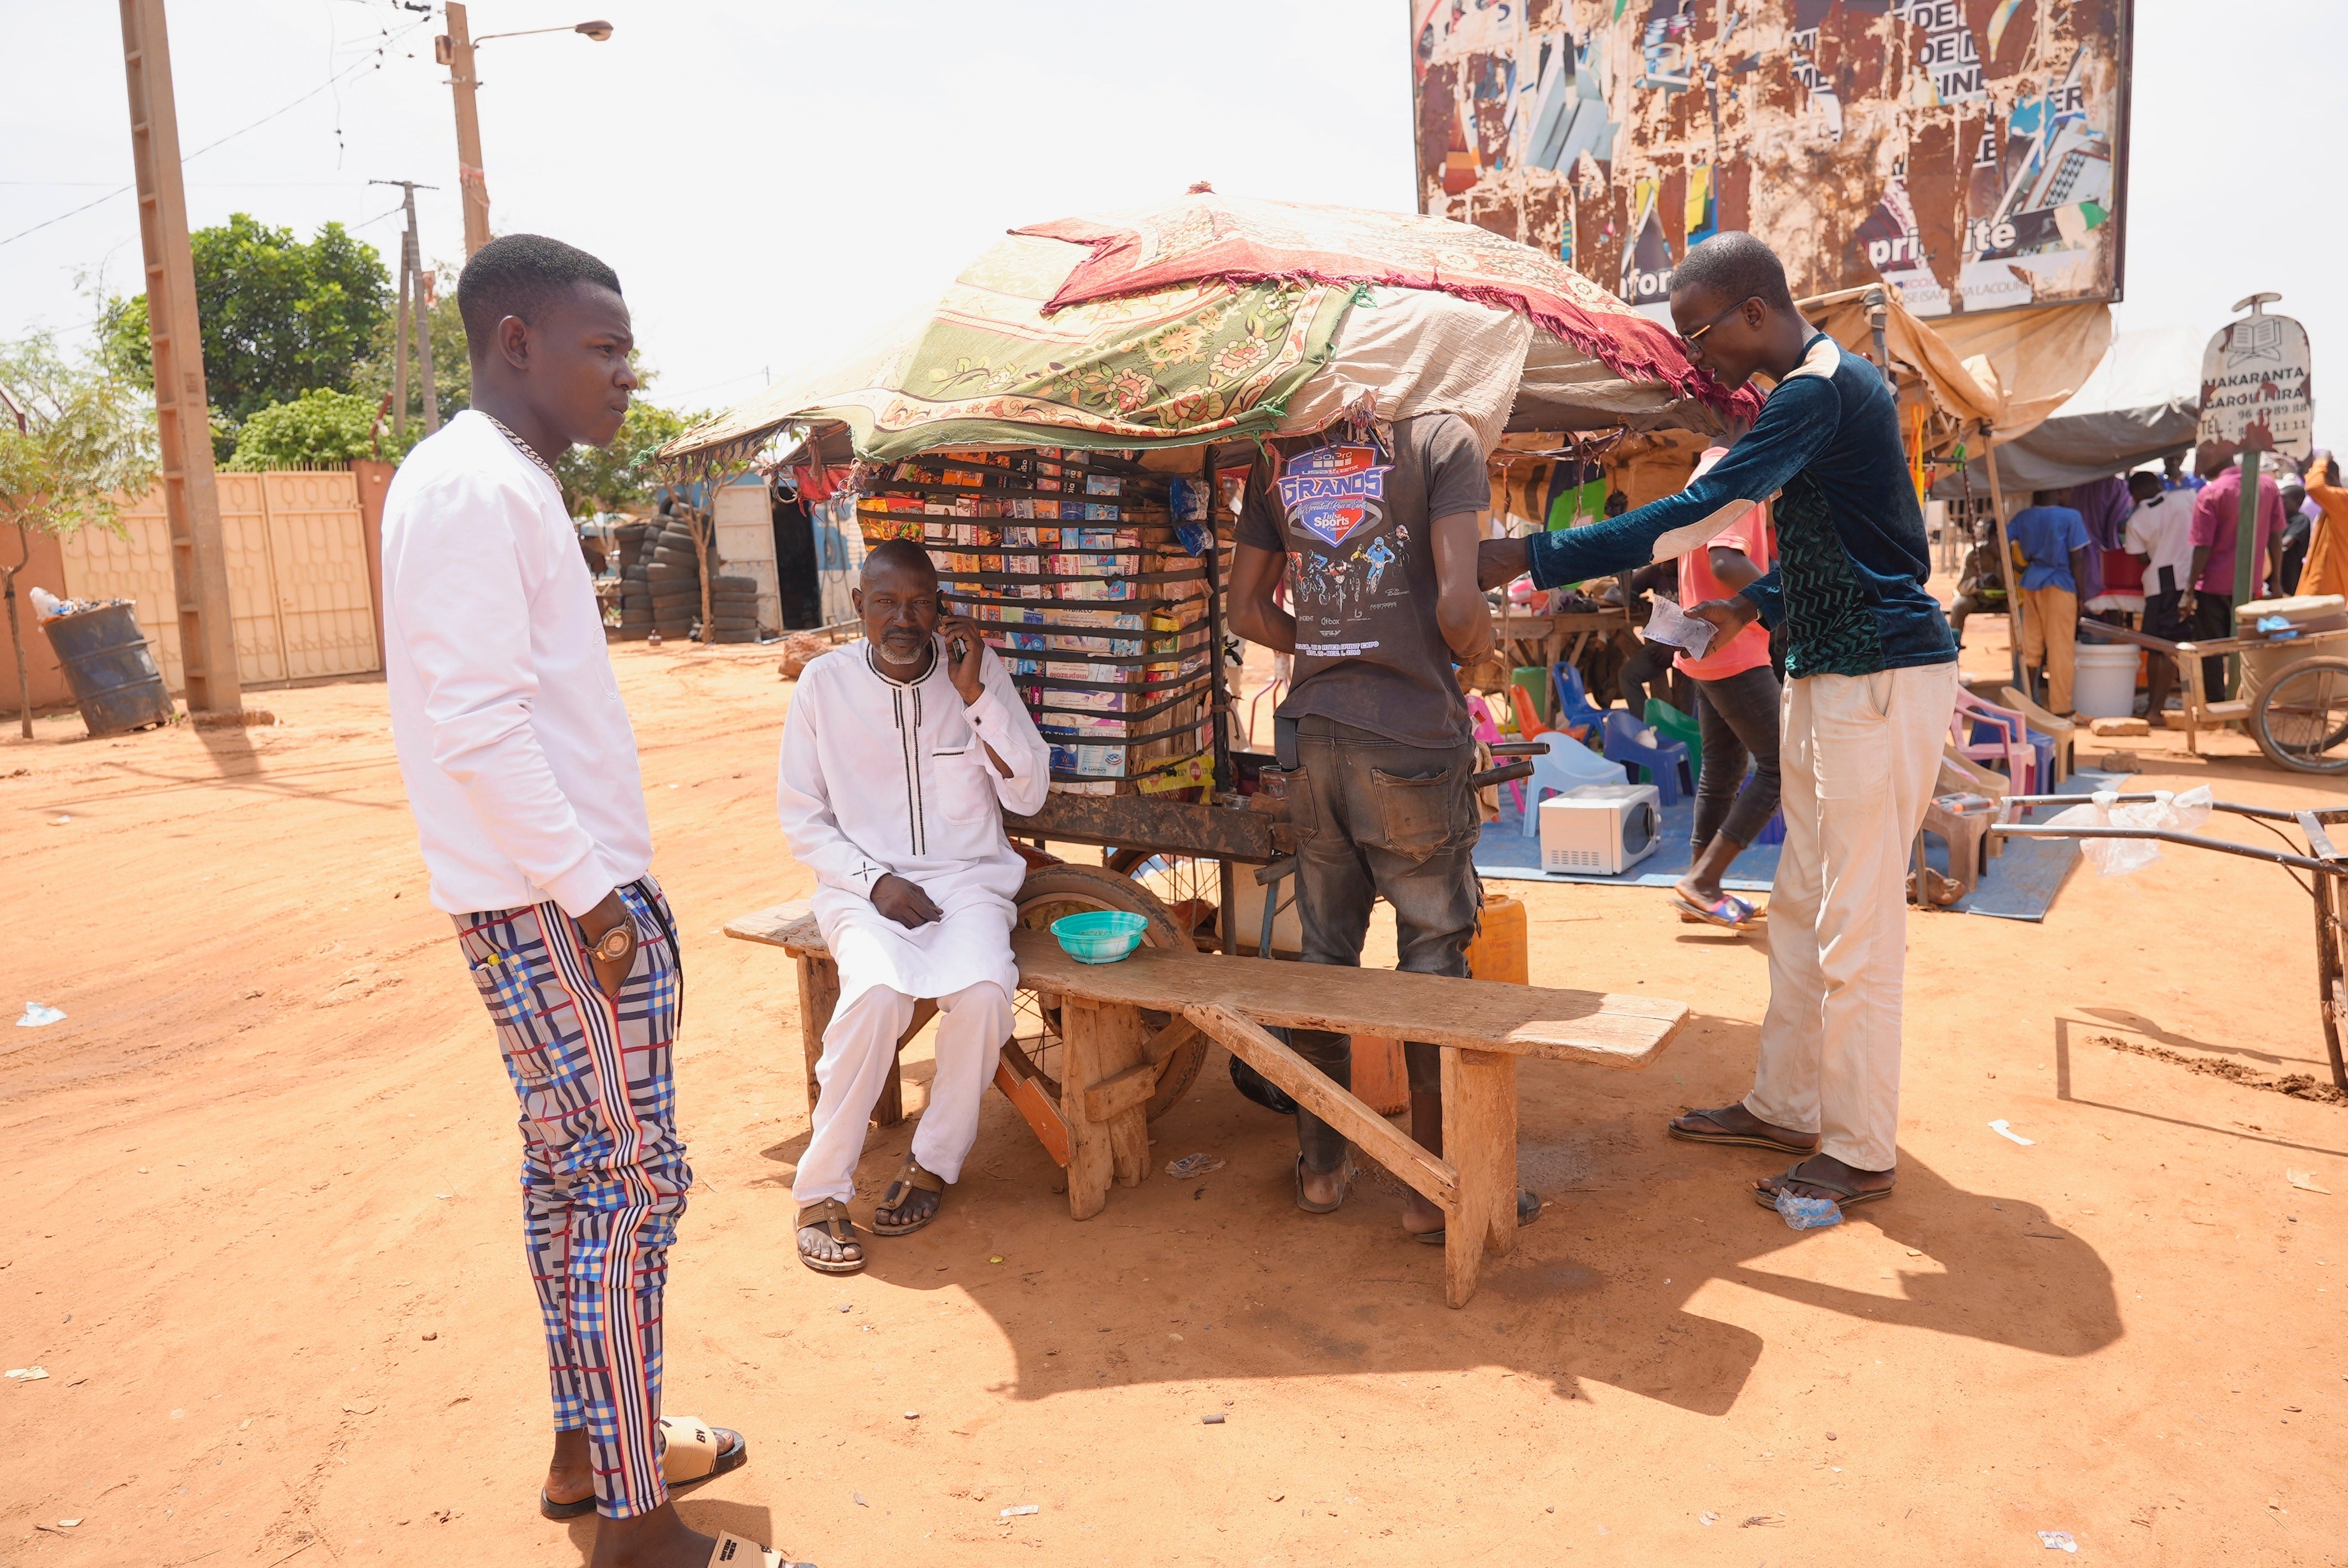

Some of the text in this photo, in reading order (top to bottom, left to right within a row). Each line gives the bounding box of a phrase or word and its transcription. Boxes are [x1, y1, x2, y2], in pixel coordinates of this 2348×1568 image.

[1277, 468, 1386, 513] GRANDS
[1314, 516, 1350, 529] Sports
[1049, 672, 1088, 680] meprazole
